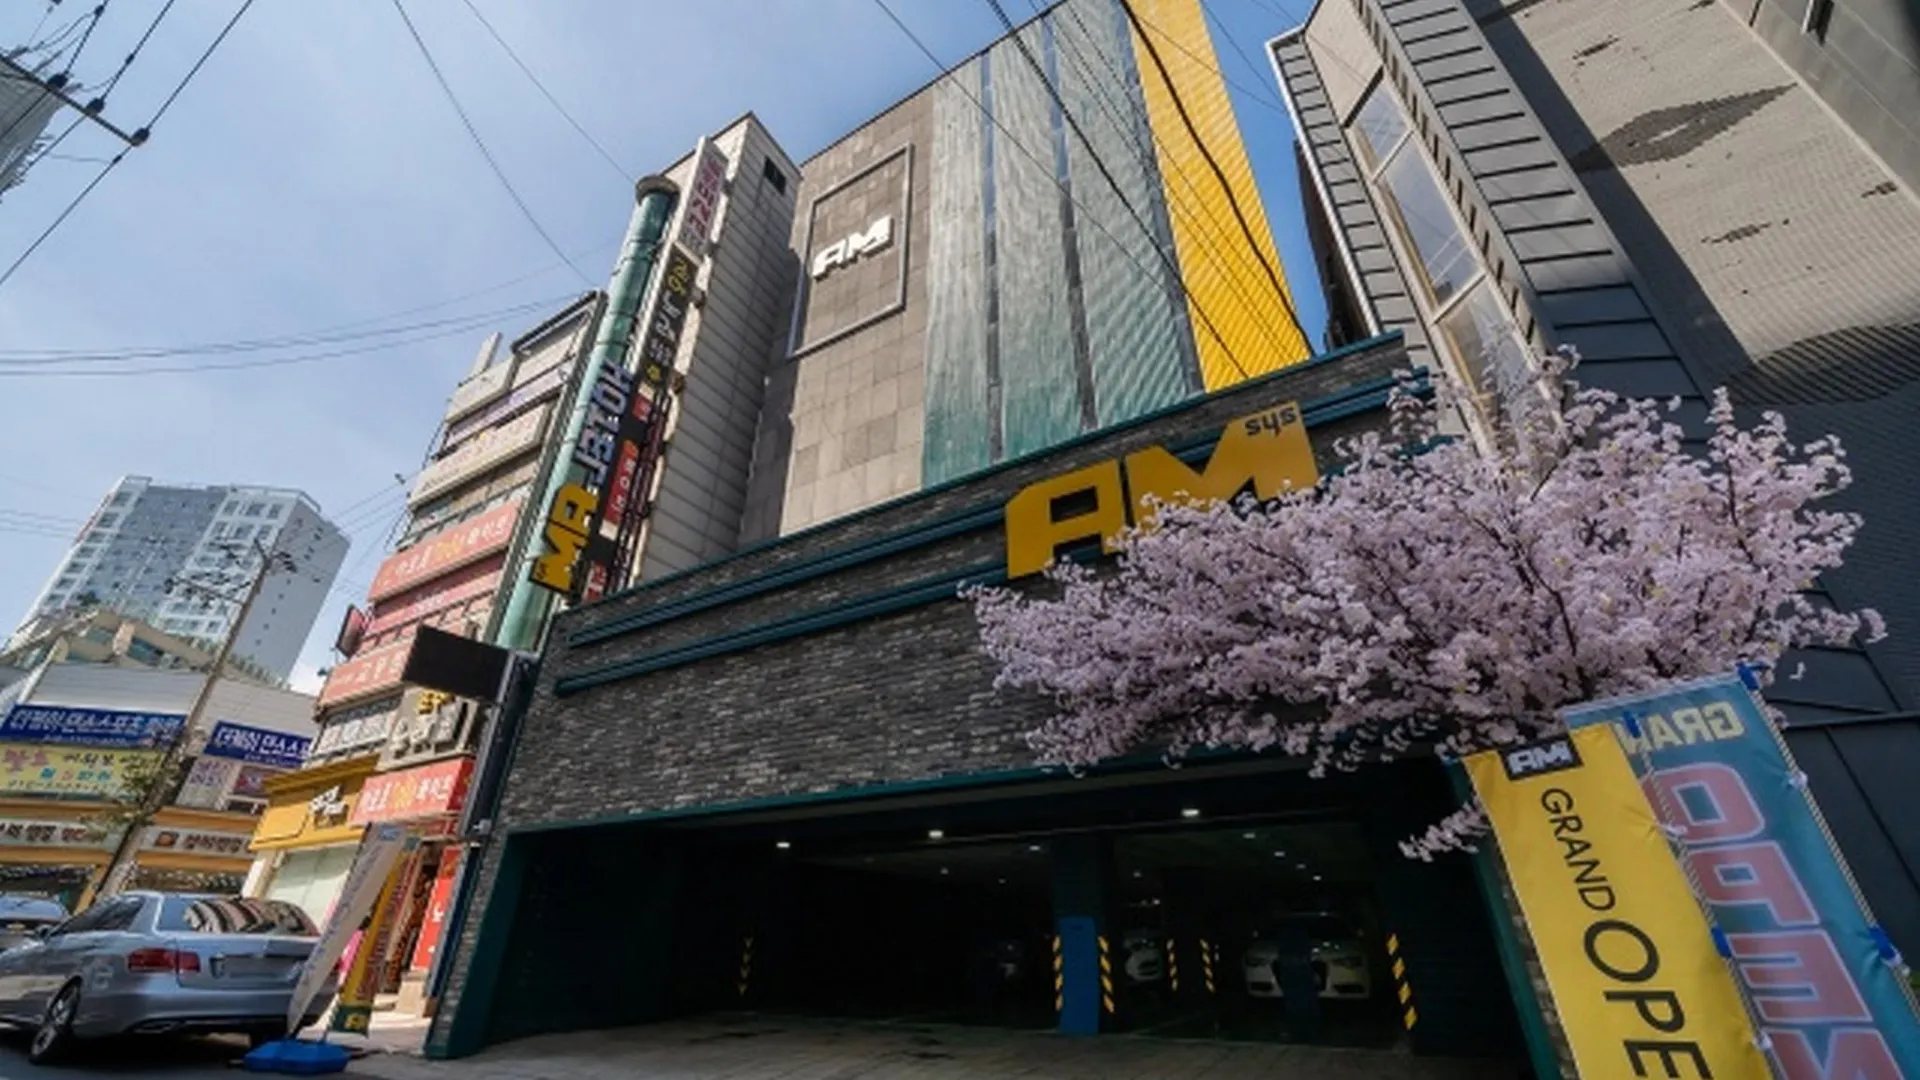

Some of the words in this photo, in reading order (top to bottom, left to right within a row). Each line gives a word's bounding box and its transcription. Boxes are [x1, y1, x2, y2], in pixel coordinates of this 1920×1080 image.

[812, 214, 890, 277] AM
[1245, 407, 1297, 435] sys
[1006, 401, 1319, 579] AM
[1506, 740, 1574, 776] AM
[1540, 787, 1616, 912] GRAND
